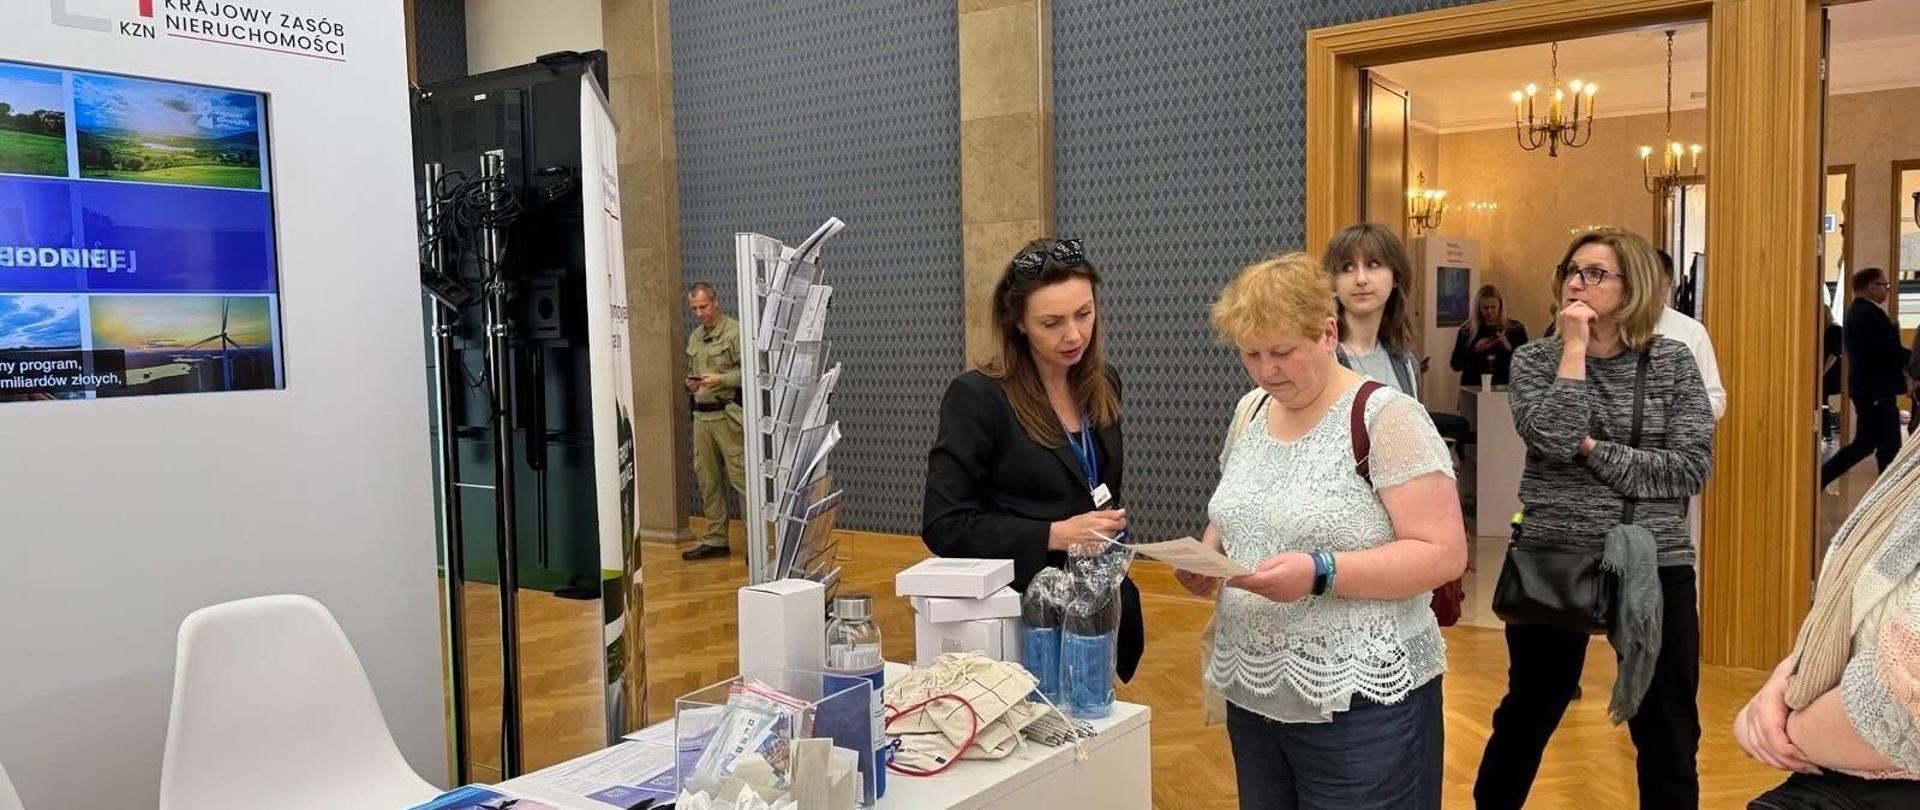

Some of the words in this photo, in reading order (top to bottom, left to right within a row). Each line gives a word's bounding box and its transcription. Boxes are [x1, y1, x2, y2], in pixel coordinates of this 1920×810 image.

[165, 0, 272, 25] KRAJOWY
[279, 13, 345, 37] ZASÓB
[119, 21, 156, 40] KZN
[165, 14, 345, 56] NIERUCHOMOŚCI
[20, 359, 82, 374] program,
[0, 374, 67, 389] miliardów
[71, 372, 122, 387] złotych,
